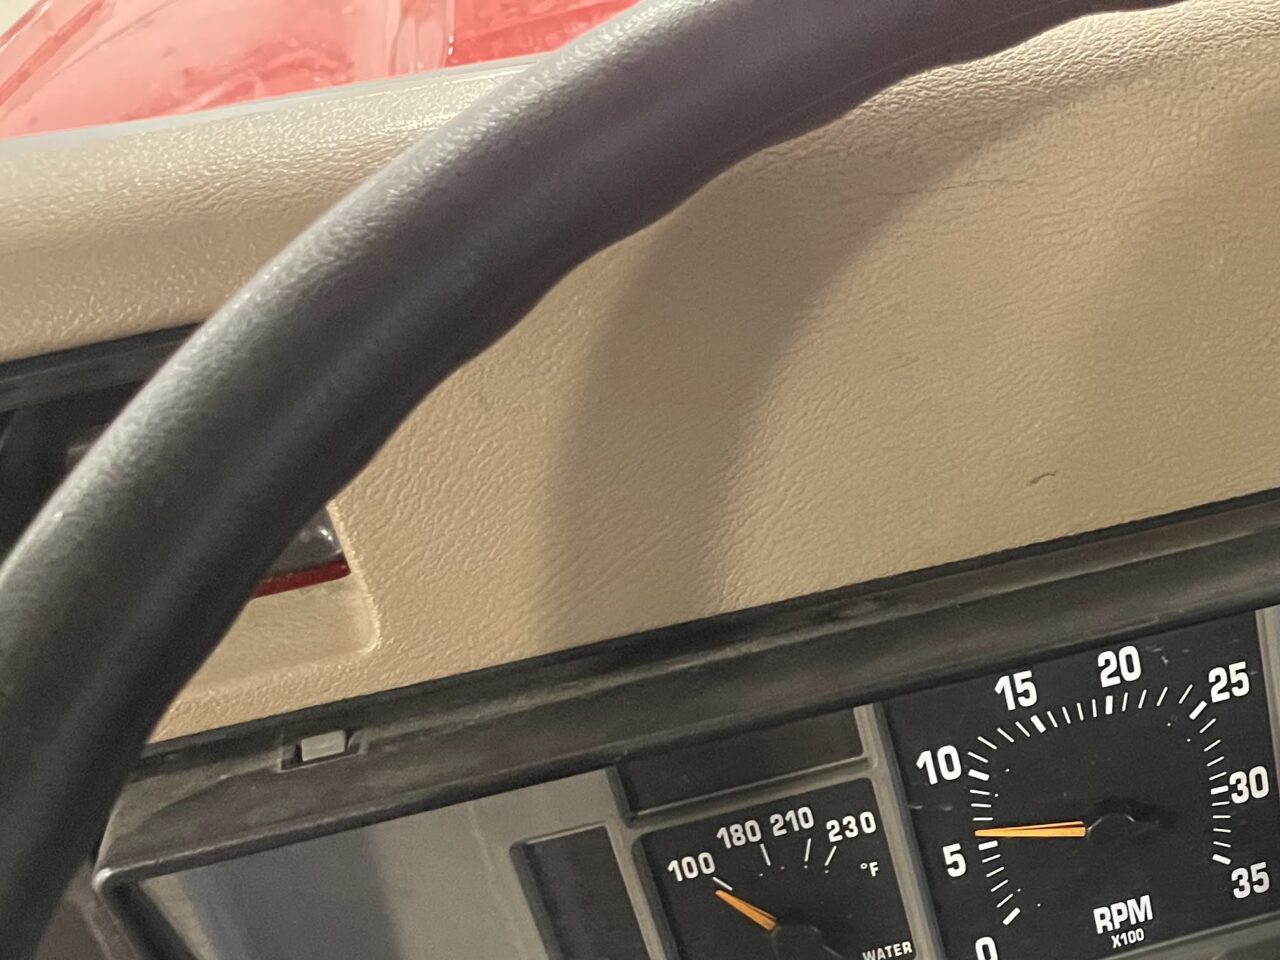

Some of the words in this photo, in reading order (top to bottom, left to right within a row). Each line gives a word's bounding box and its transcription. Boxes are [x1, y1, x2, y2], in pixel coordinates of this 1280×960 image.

[1097, 645, 1142, 688] 20
[1208, 661, 1250, 703] 25
[994, 670, 1038, 711] 15
[916, 744, 962, 785] 10
[1229, 766, 1270, 804] 30
[716, 819, 762, 849] 180
[768, 806, 814, 837] 210
[825, 811, 877, 842] 230
[667, 852, 716, 882] 100
[942, 842, 967, 878] 5
[1231, 862, 1270, 899] 35
[1093, 894, 1153, 934] RPM
[1111, 928, 1145, 949] X100
